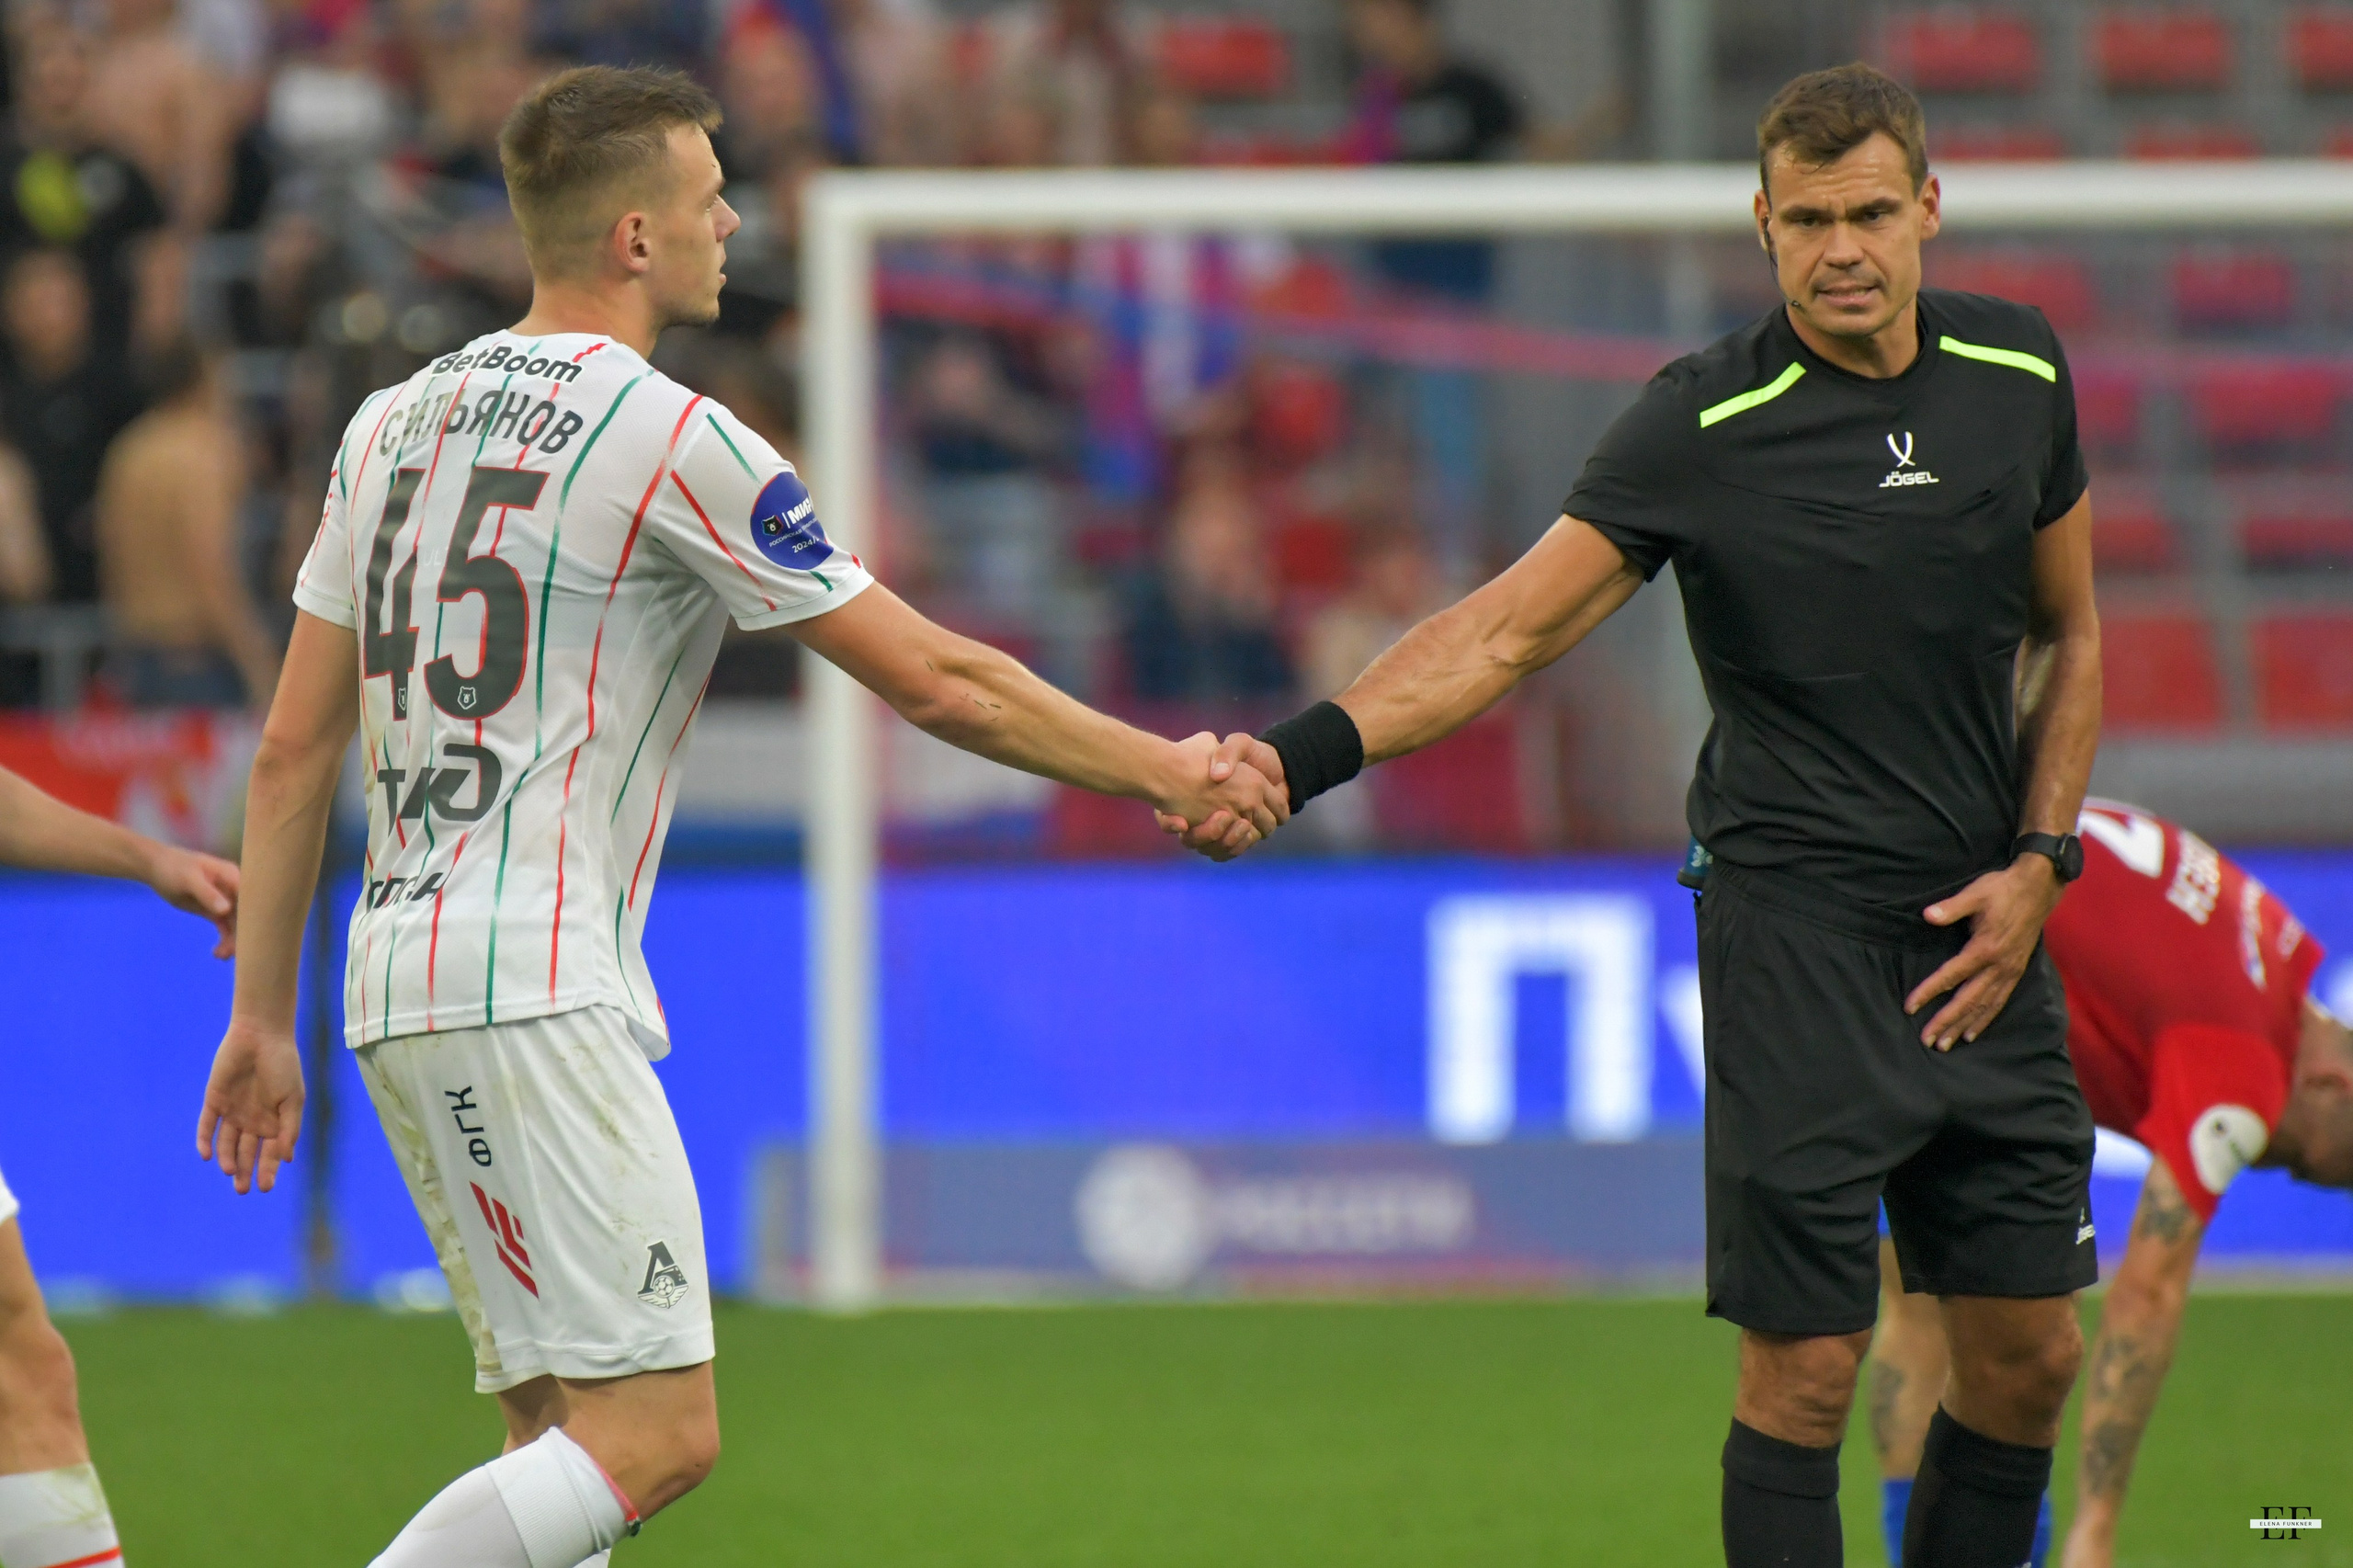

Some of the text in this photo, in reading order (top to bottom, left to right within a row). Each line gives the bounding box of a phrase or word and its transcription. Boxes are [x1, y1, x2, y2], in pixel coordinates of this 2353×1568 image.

[432, 347, 583, 383] BetBoom
[379, 388, 584, 457] СИЛЬЯНОВ
[1879, 471, 1939, 487] JÖGEL
[363, 467, 551, 721] 45
[445, 1085, 493, 1167] ФГК
